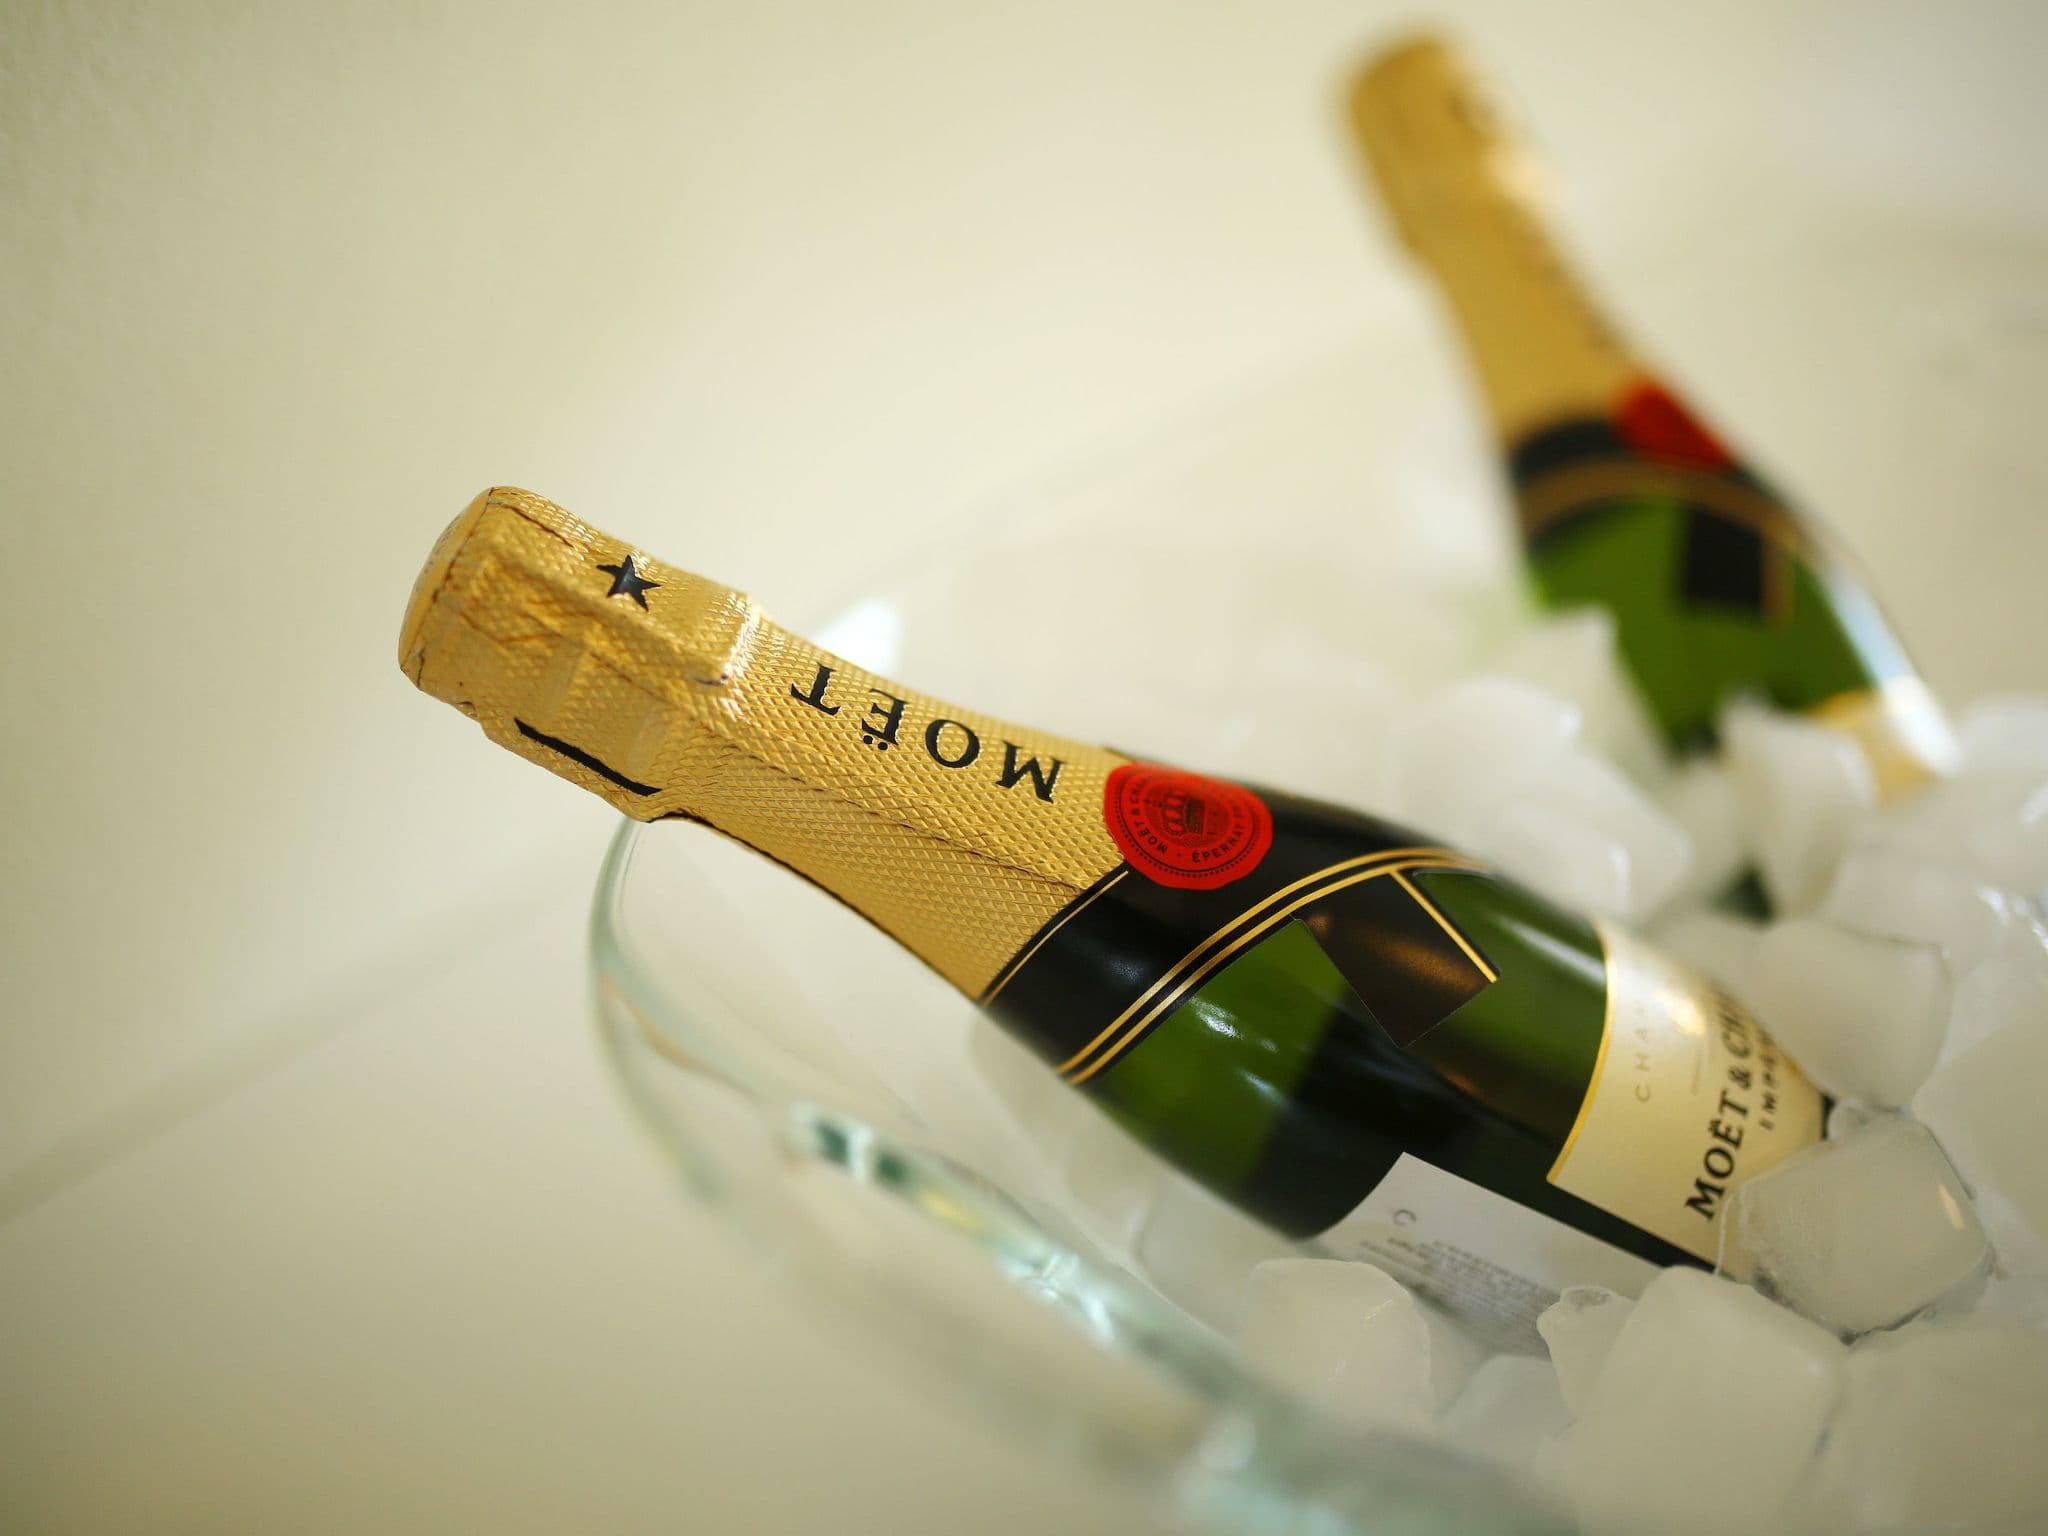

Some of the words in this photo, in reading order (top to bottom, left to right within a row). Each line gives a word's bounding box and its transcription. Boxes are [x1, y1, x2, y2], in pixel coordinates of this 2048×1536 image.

[789, 662, 1065, 804] MOËT
[1684, 1090, 1748, 1222] MOËT
[1727, 1065, 1752, 1091] &
